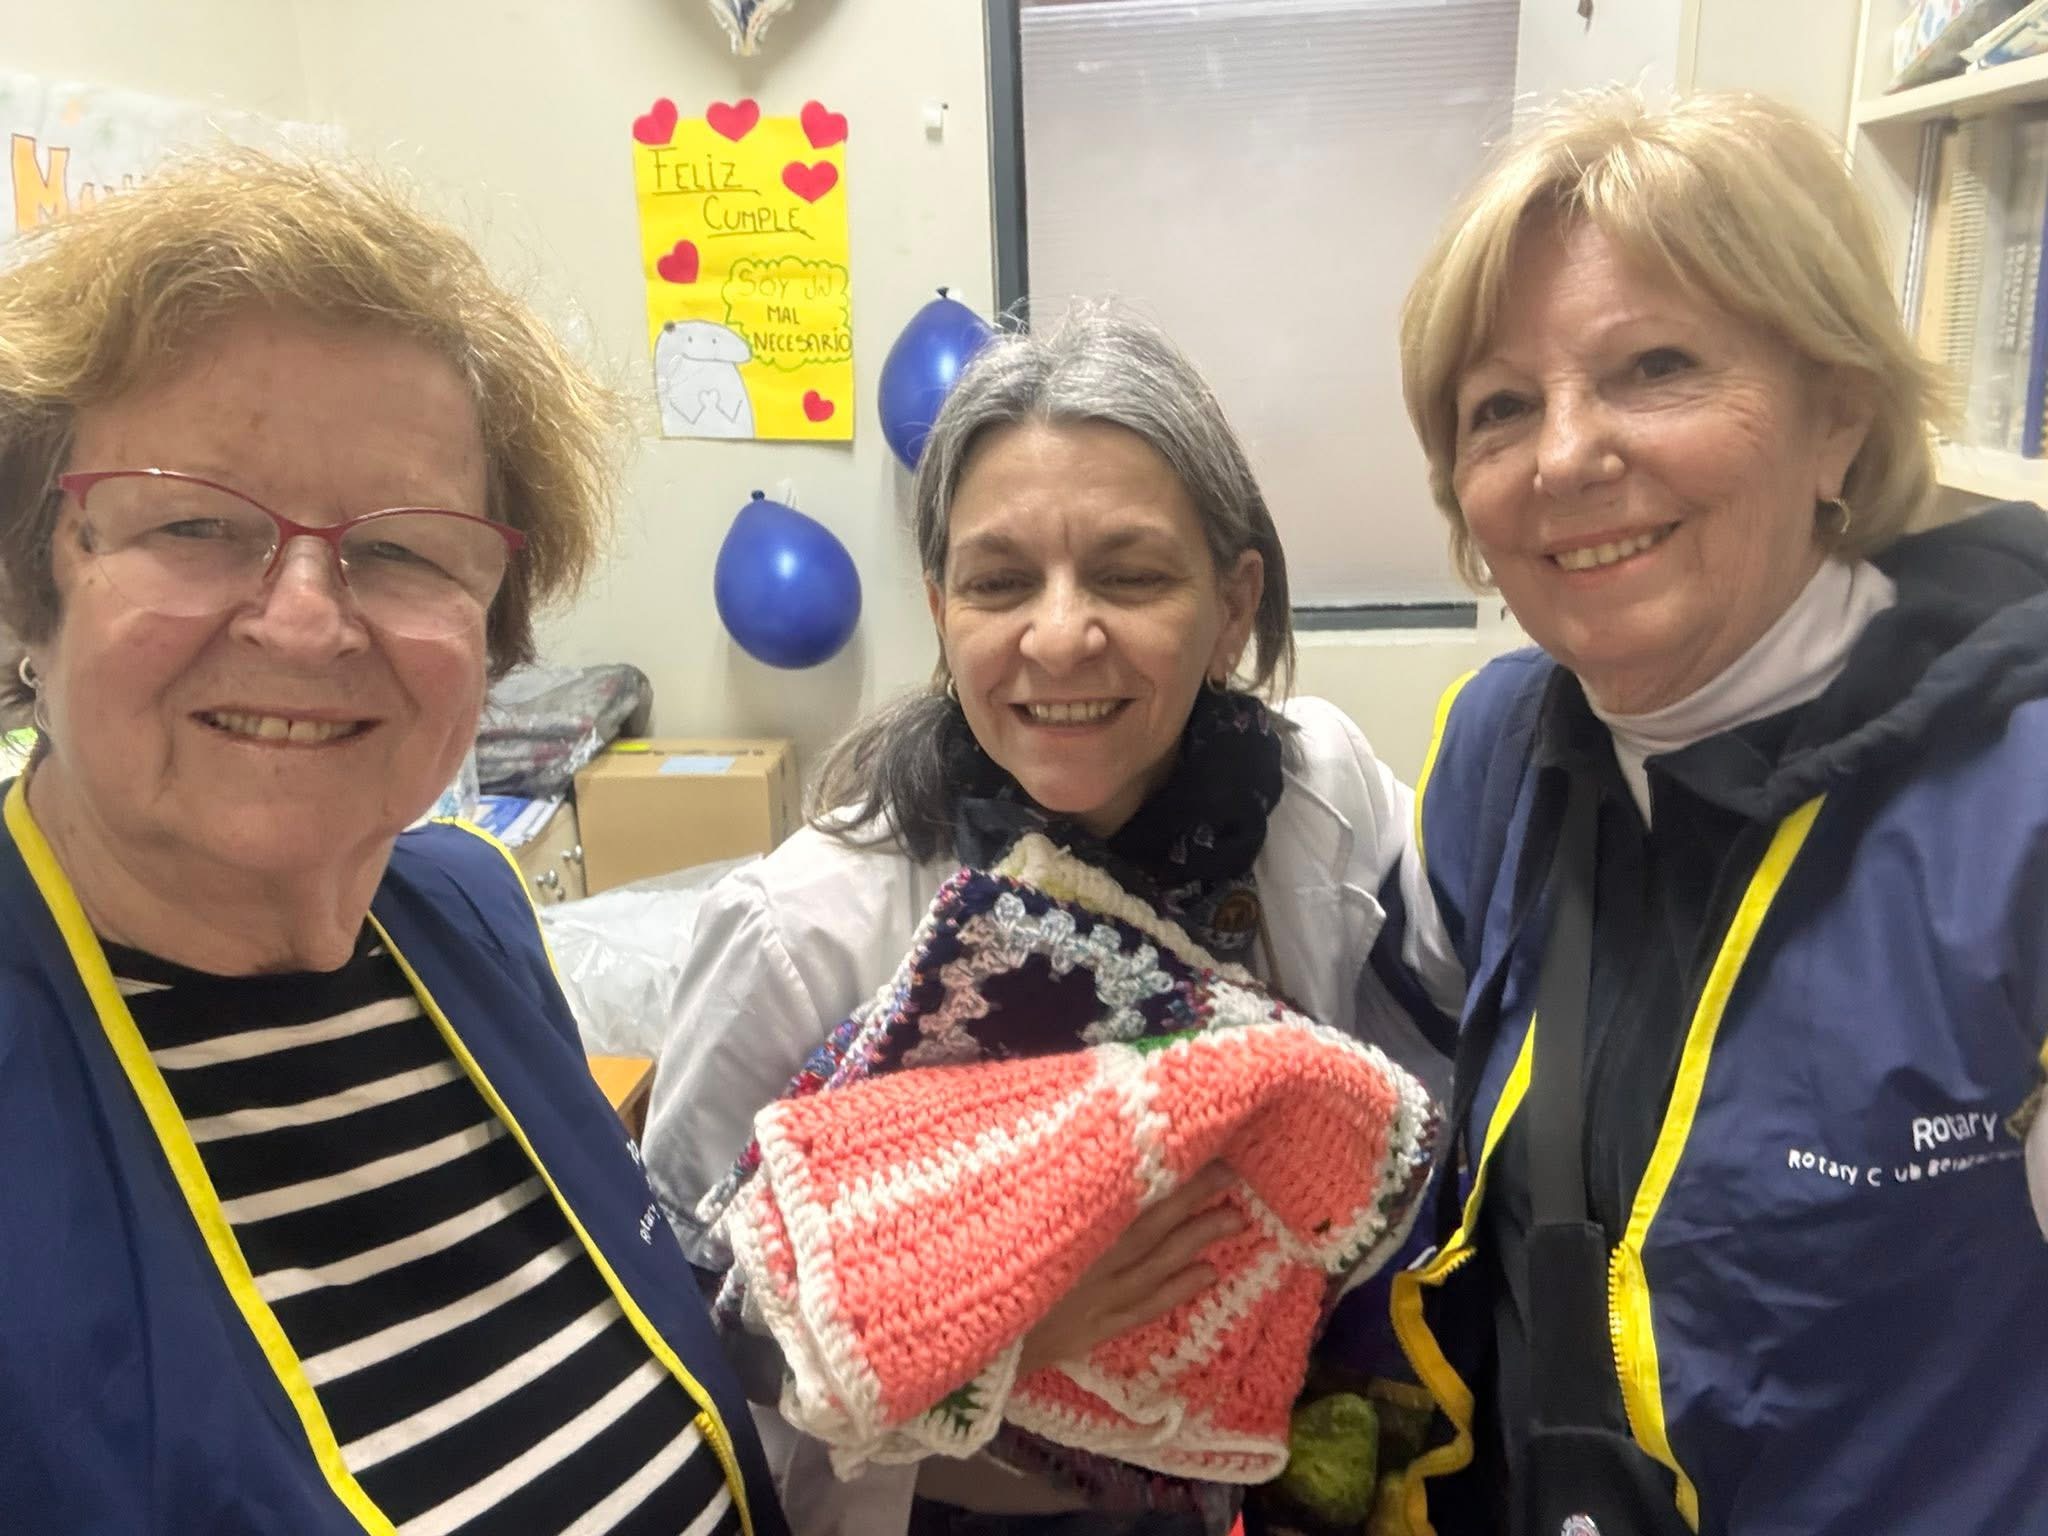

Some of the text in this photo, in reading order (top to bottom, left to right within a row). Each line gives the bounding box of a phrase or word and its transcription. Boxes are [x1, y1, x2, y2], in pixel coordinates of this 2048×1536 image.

[703, 194, 801, 233] CUMPLE
[739, 268, 790, 300] SOY
[767, 304, 800, 325] MAL
[753, 327, 851, 353] NECESARIO
[1912, 1112, 1998, 1152] Rotary
[1788, 1149, 1858, 1186] Rotary
[1866, 1162, 1922, 1187] Cub
